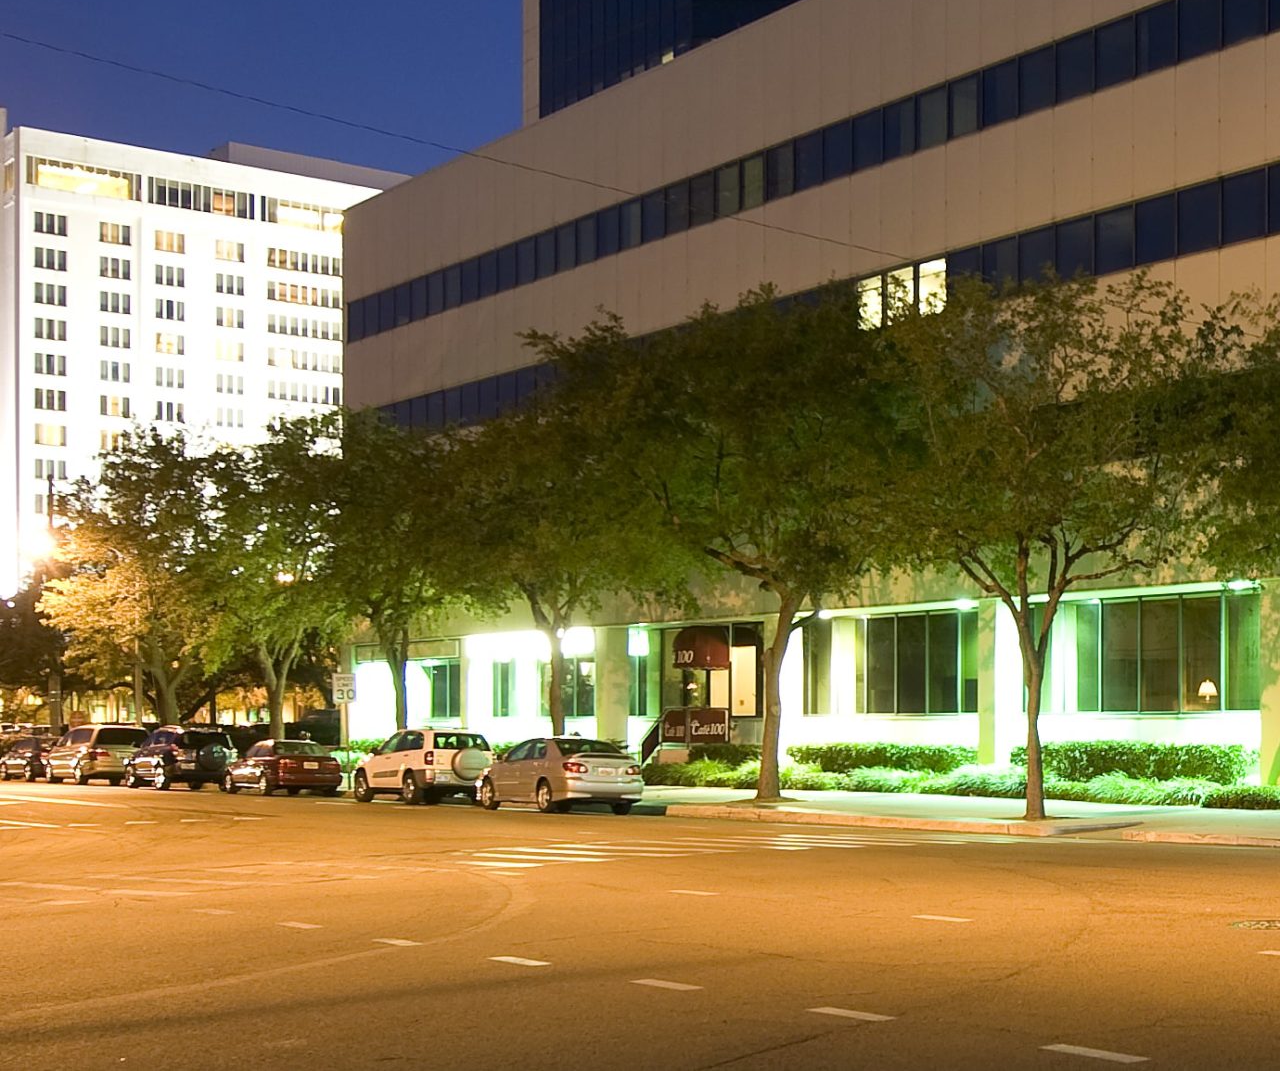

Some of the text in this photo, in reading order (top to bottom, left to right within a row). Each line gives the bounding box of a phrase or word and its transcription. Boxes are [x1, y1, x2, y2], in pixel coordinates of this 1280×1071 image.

[677, 650, 693, 663] 100
[336, 689, 355, 700] 30
[710, 723, 725, 734] 100
